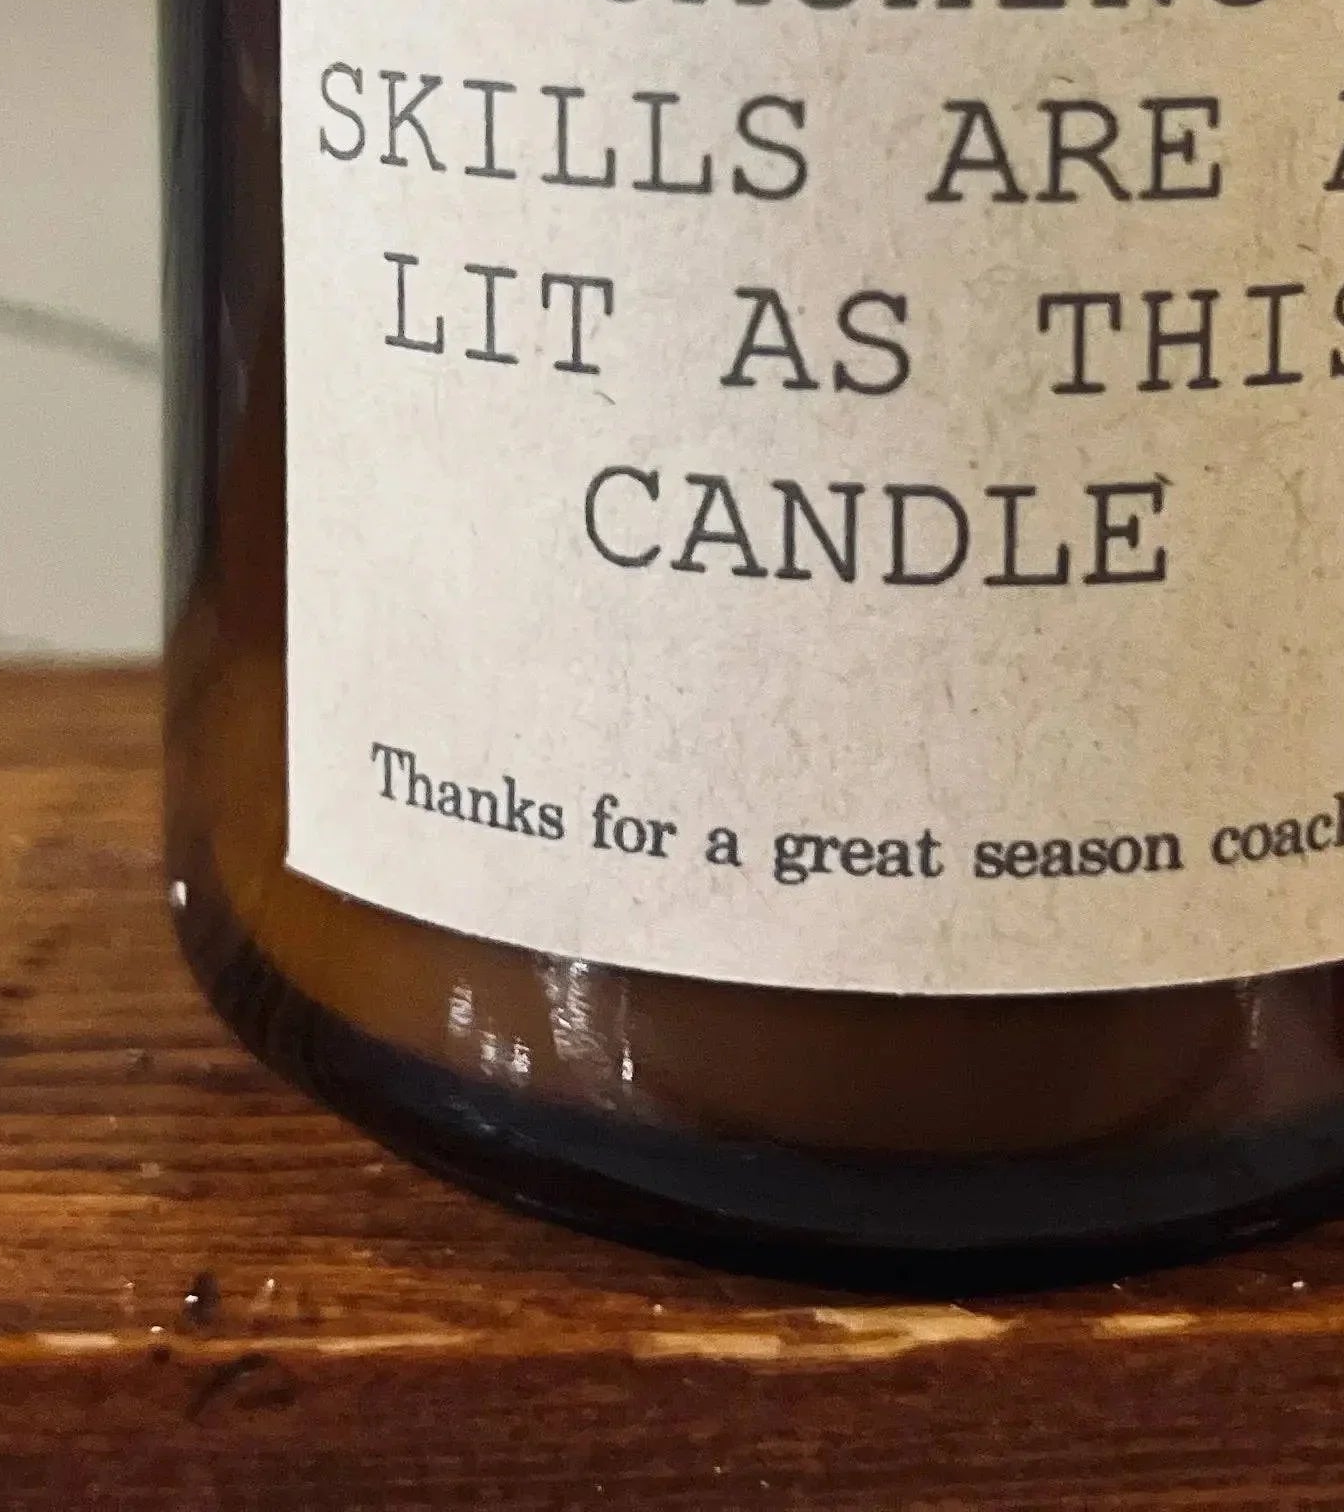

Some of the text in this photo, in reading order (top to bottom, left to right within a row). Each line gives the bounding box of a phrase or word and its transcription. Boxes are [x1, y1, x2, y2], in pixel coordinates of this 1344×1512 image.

[318, 60, 808, 202] SKILLS
[924, 96, 1223, 206] ARE
[382, 250, 615, 376] LIT
[719, 286, 912, 397] AS
[584, 464, 1174, 588] CANDLE
[370, 740, 566, 842] Thanks
[590, 791, 678, 860] for
[704, 825, 744, 869] a
[772, 827, 945, 887] great
[972, 830, 1185, 882] season
